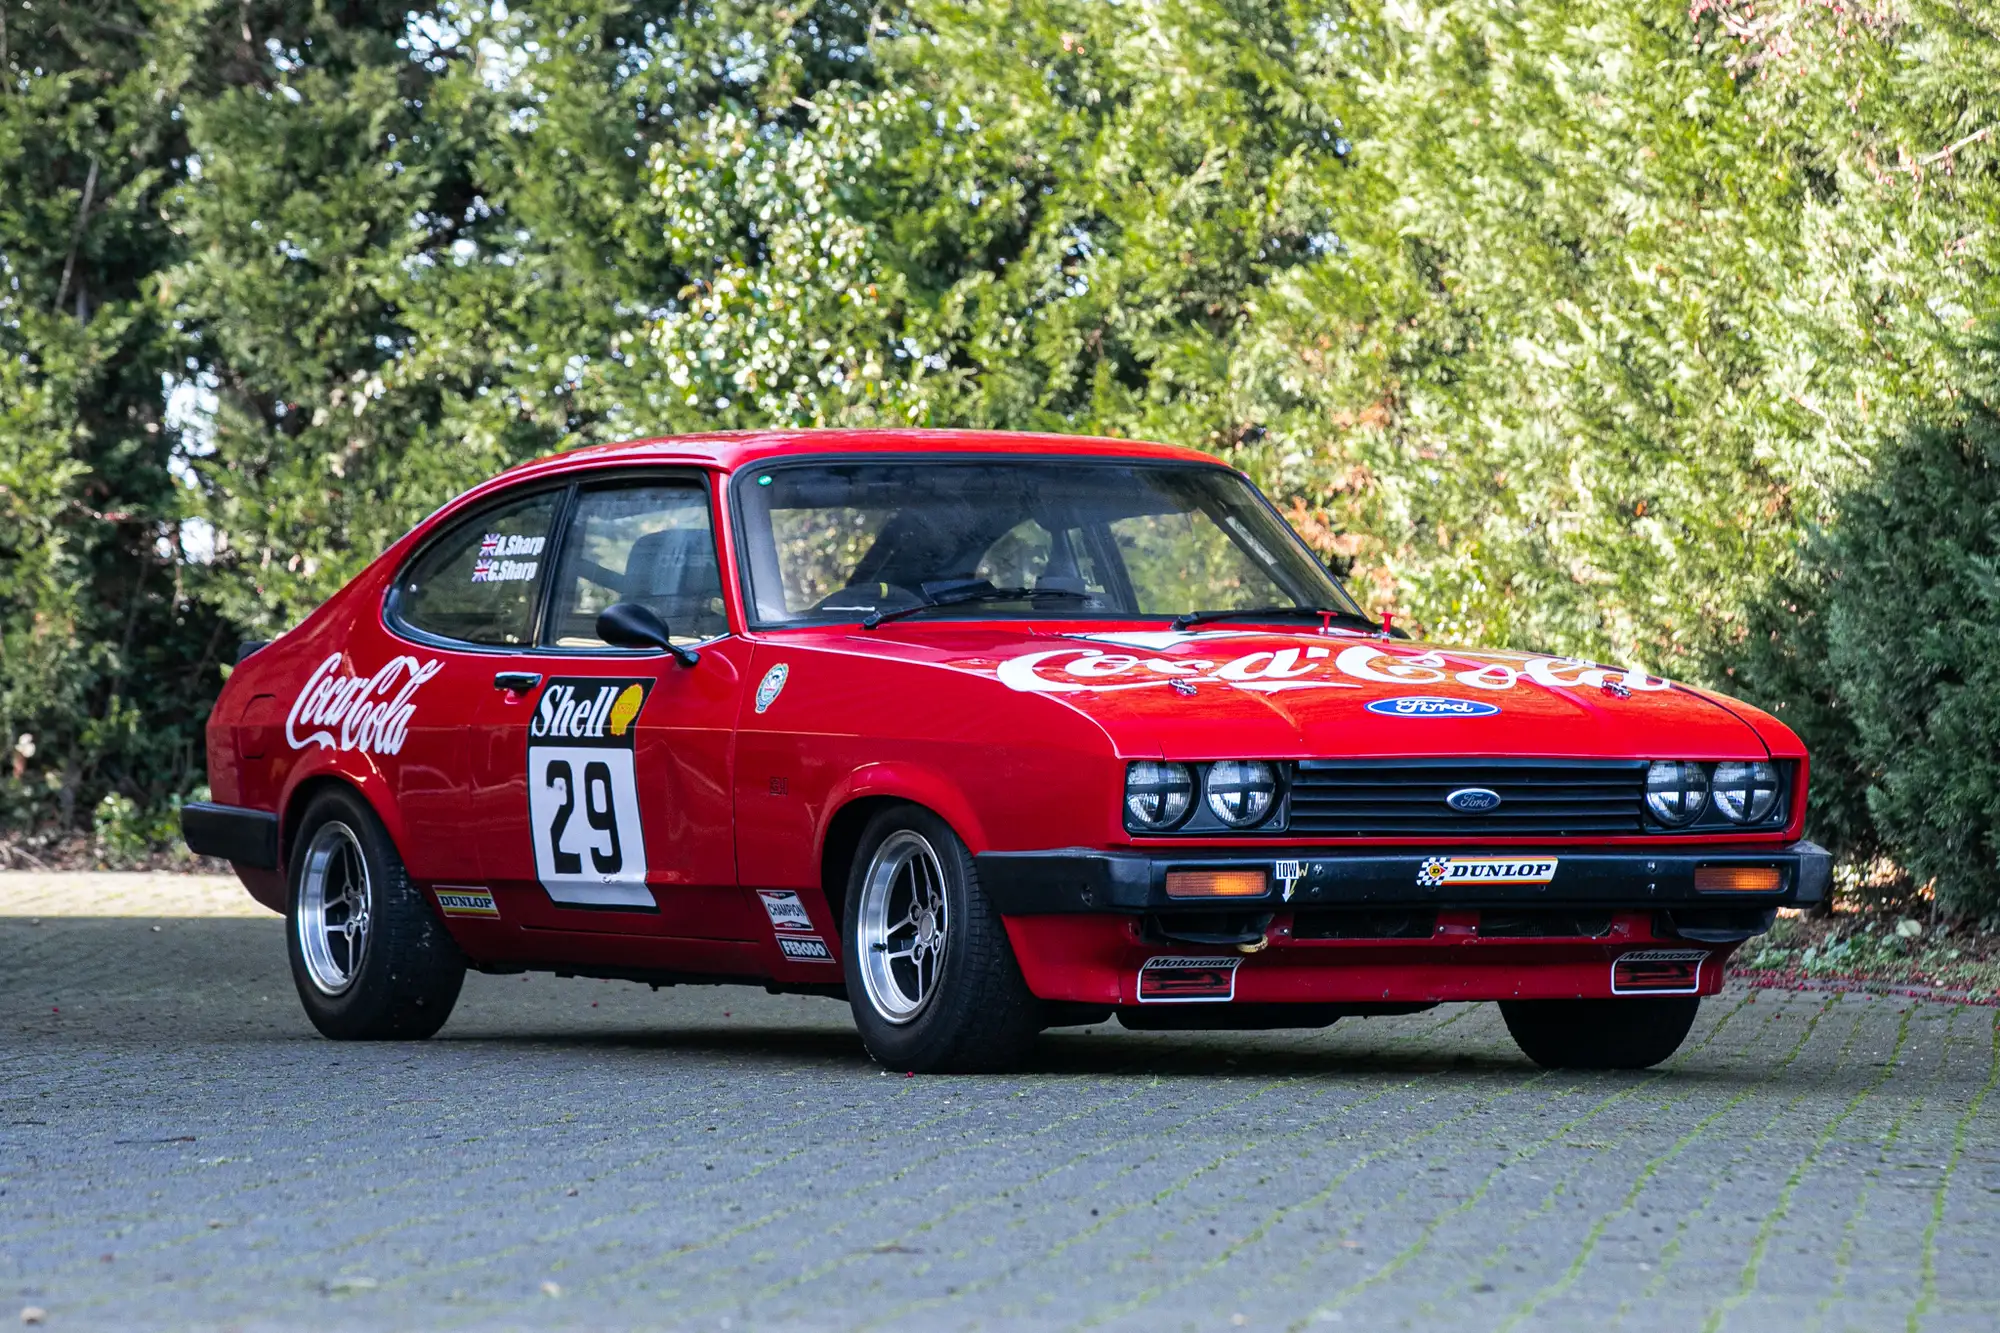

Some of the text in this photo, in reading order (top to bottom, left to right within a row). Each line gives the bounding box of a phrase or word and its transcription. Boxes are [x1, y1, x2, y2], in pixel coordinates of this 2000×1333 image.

[531, 684, 619, 737] Shell
[1395, 699, 1474, 713] Ford
[1460, 793, 1491, 808] Ford
[546, 760, 622, 874] 29
[1277, 862, 1297, 878] TOW
[1450, 863, 1552, 877] DUNLOP
[439, 895, 492, 908] DUNLOP
[767, 903, 806, 917] CHAMPION
[781, 940, 826, 956] FERODO
[1623, 951, 1706, 960] Motorcraft
[1149, 958, 1238, 968] Motorcraft
